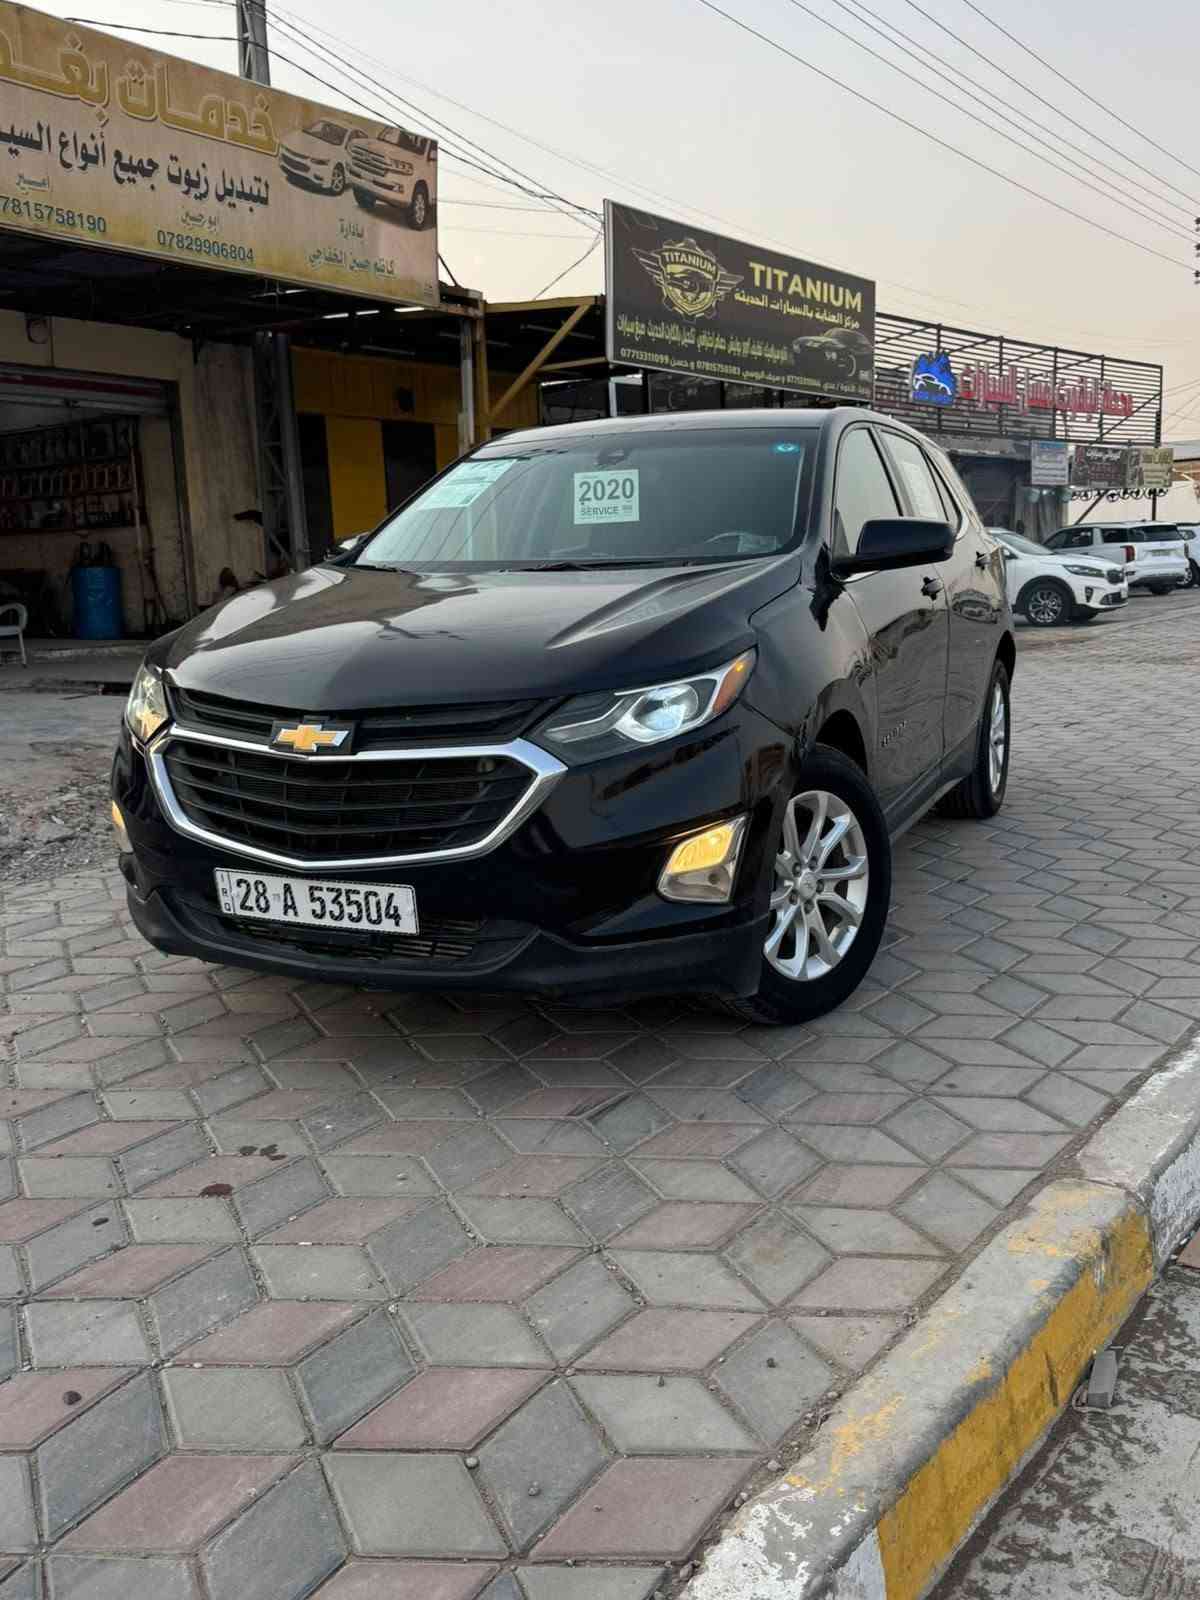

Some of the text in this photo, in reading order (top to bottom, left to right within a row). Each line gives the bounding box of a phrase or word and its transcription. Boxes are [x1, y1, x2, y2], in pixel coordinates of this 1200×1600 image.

[115, 60, 280, 158] خدمات
[58, 130, 106, 171] أنواع
[113, 148, 160, 191] جميع
[167, 153, 209, 200] زيوت
[215, 168, 269, 213] لتبديل
[157, 229, 255, 261] 07829906804
[661, 250, 717, 274] TITANIUM
[749, 261, 862, 312] TITANIUM
[579, 478, 634, 501] 2020
[580, 505, 619, 516] SERVICE
[236, 878, 402, 927] 28 A 53504
